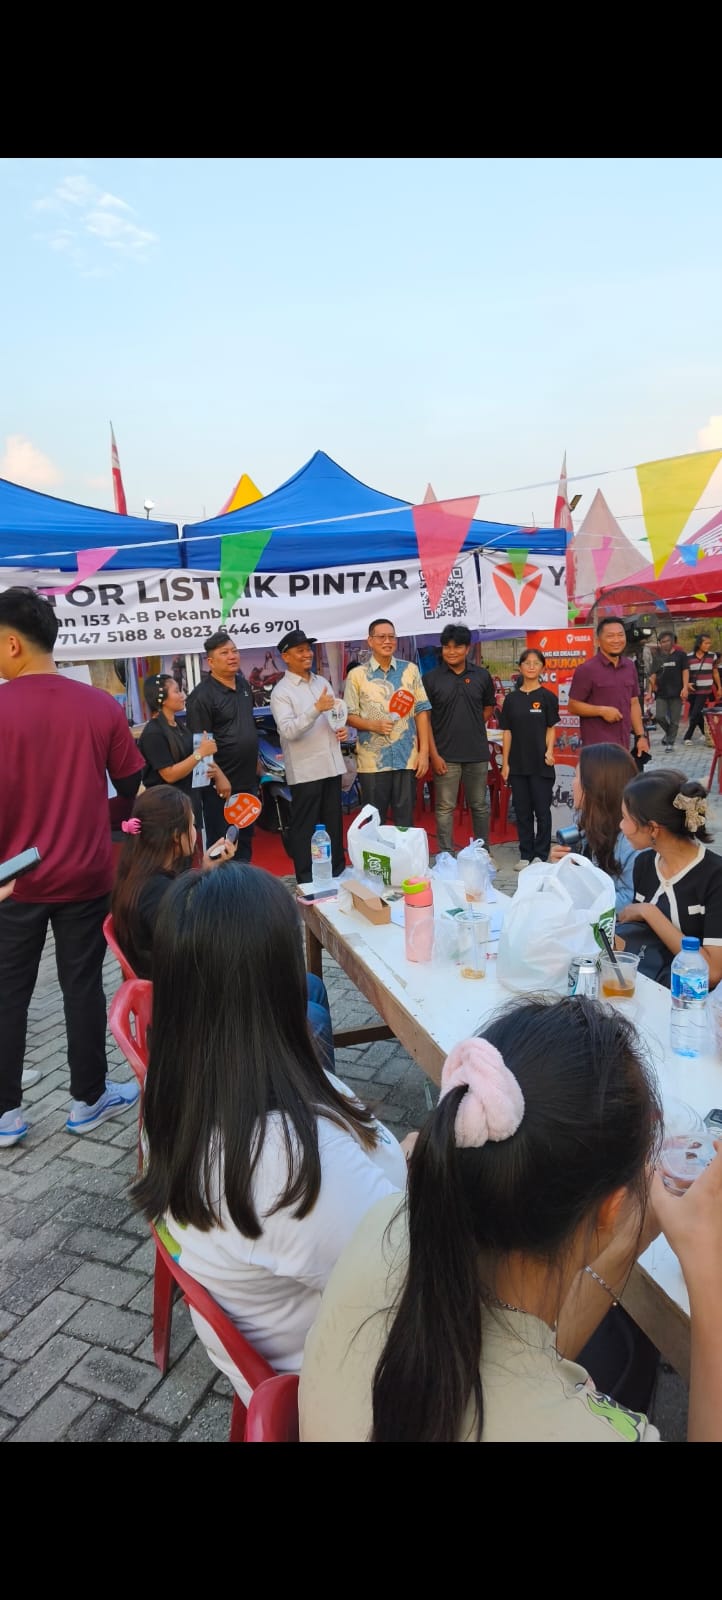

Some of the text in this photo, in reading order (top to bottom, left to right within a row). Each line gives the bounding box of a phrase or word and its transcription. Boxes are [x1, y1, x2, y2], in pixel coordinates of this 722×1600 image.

[548, 565, 567, 586] Y
[37, 569, 409, 607] TOR LISTRIK PINTAR
[57, 617, 76, 628] an
[82, 614, 111, 627] 153
[116, 611, 149, 625] A-B
[58, 632, 101, 645] 7147
[107, 629, 147, 643] 5188
[153, 627, 166, 640] &
[171, 625, 213, 639] 0823
[265, 619, 300, 633] 9701
[545, 658, 587, 669] NJUKAN
